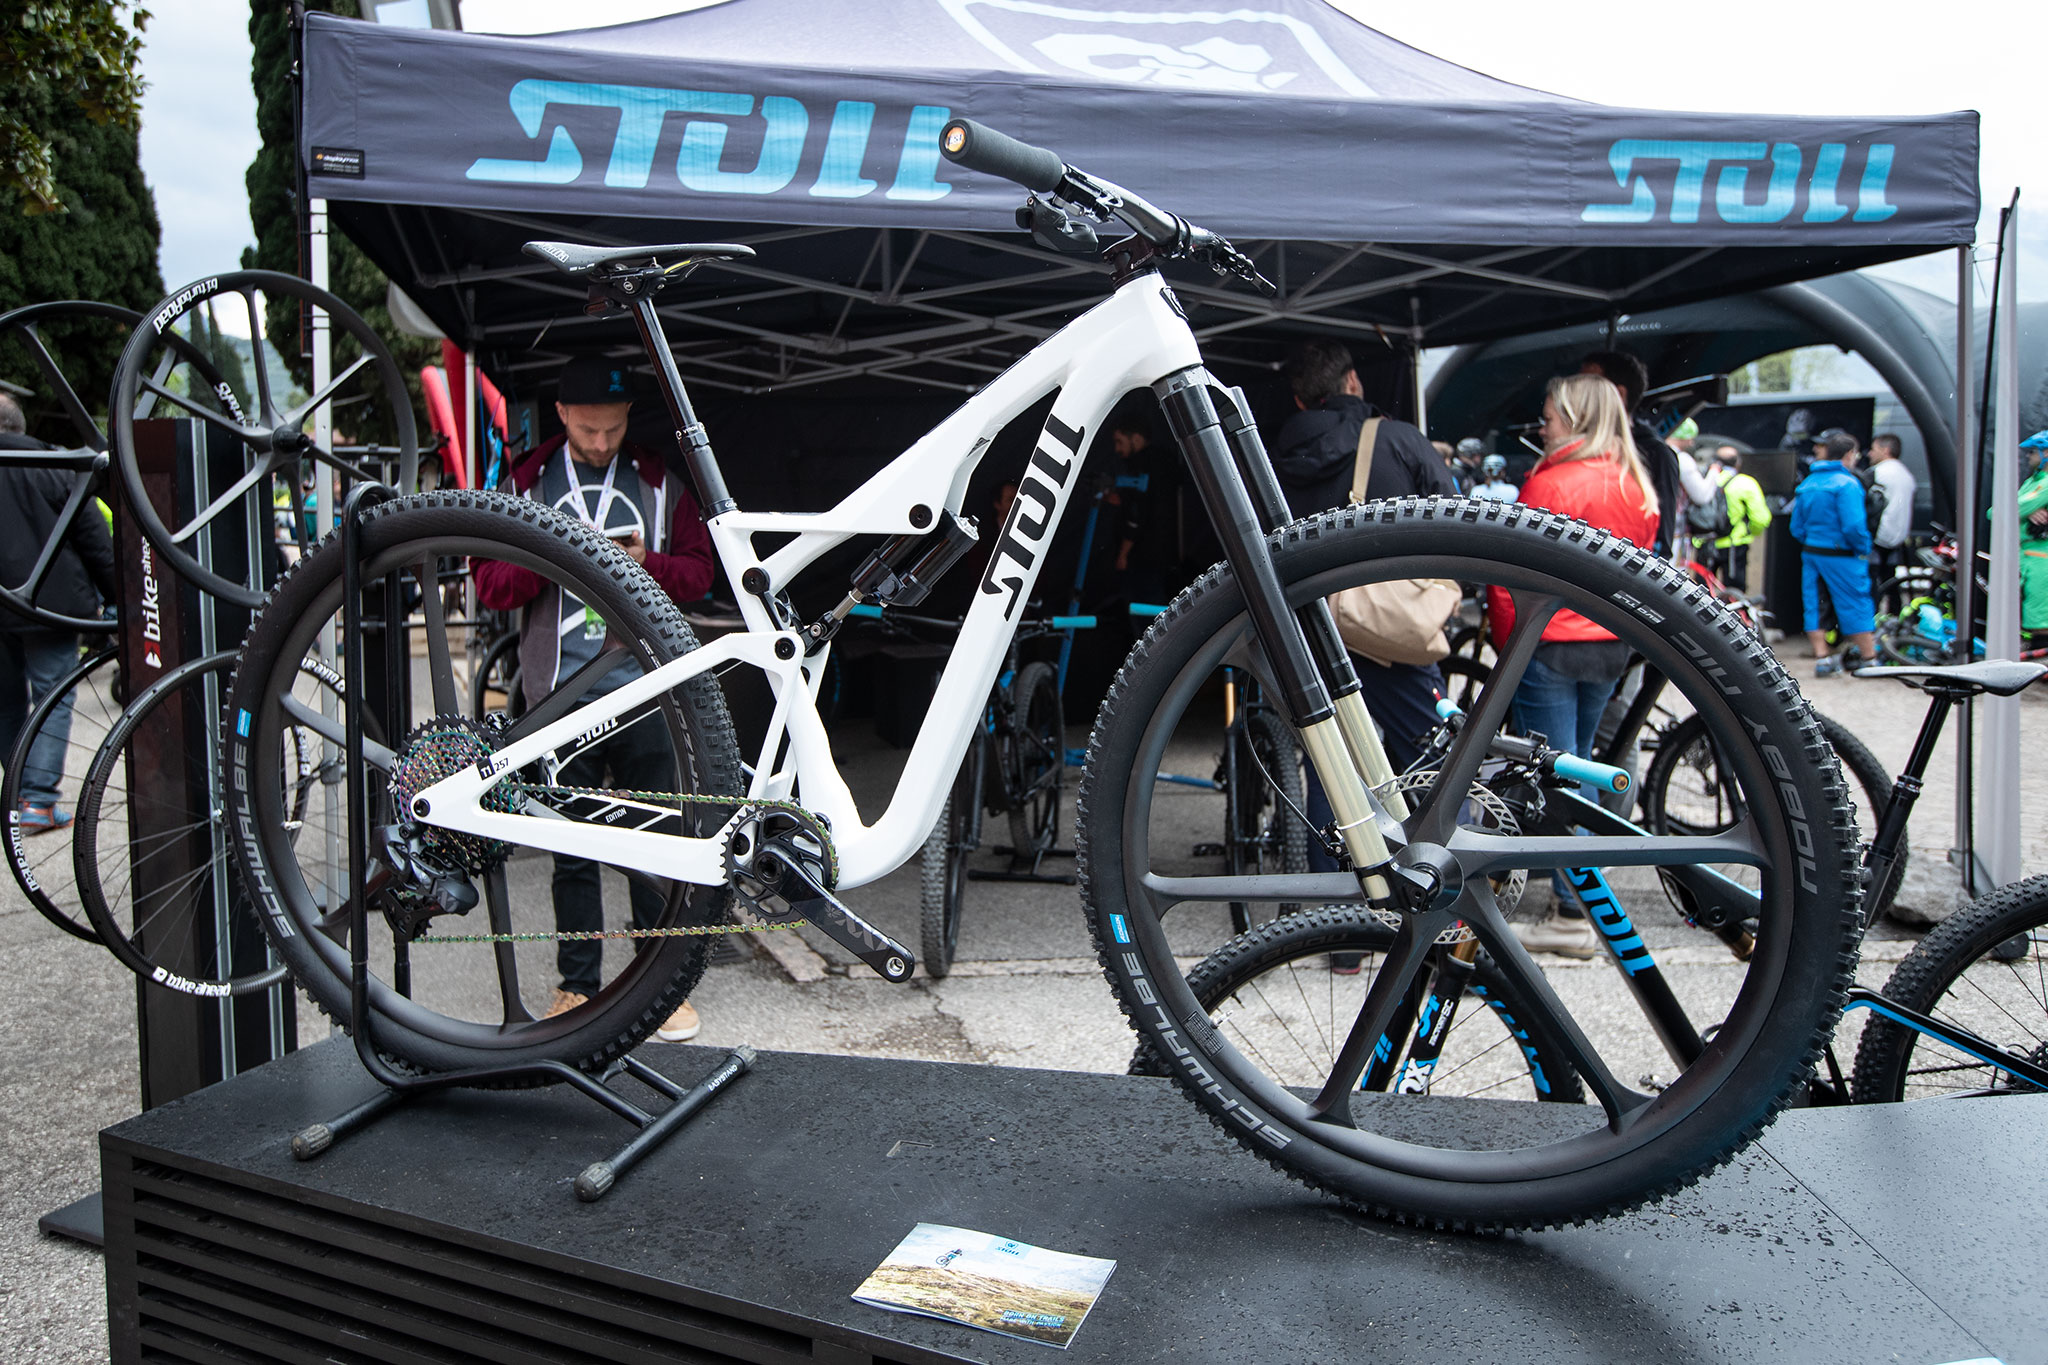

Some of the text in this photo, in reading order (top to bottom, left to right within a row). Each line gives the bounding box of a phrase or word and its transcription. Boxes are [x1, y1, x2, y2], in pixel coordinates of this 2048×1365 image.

[466, 78, 952, 202] STOLL
[1580, 139, 1898, 224] STOLL
[982, 413, 1085, 622] STOLL
[141, 536, 161, 643] bike ahea
[494, 757, 510, 772] 257
[1670, 631, 1818, 895] NOBBY NIC
[234, 741, 296, 939] SCHWALBE
[605, 807, 628, 824] EDITION
[165, 972, 232, 998] bike ahead
[707, 1064, 738, 1092] EASYSTAND
[1122, 953, 1292, 1150] SCHWALBE
[1398, 1057, 1433, 1096] OX
[1003, 1309, 1025, 1319] BORN
[1039, 1315, 1066, 1323] TRAILS
